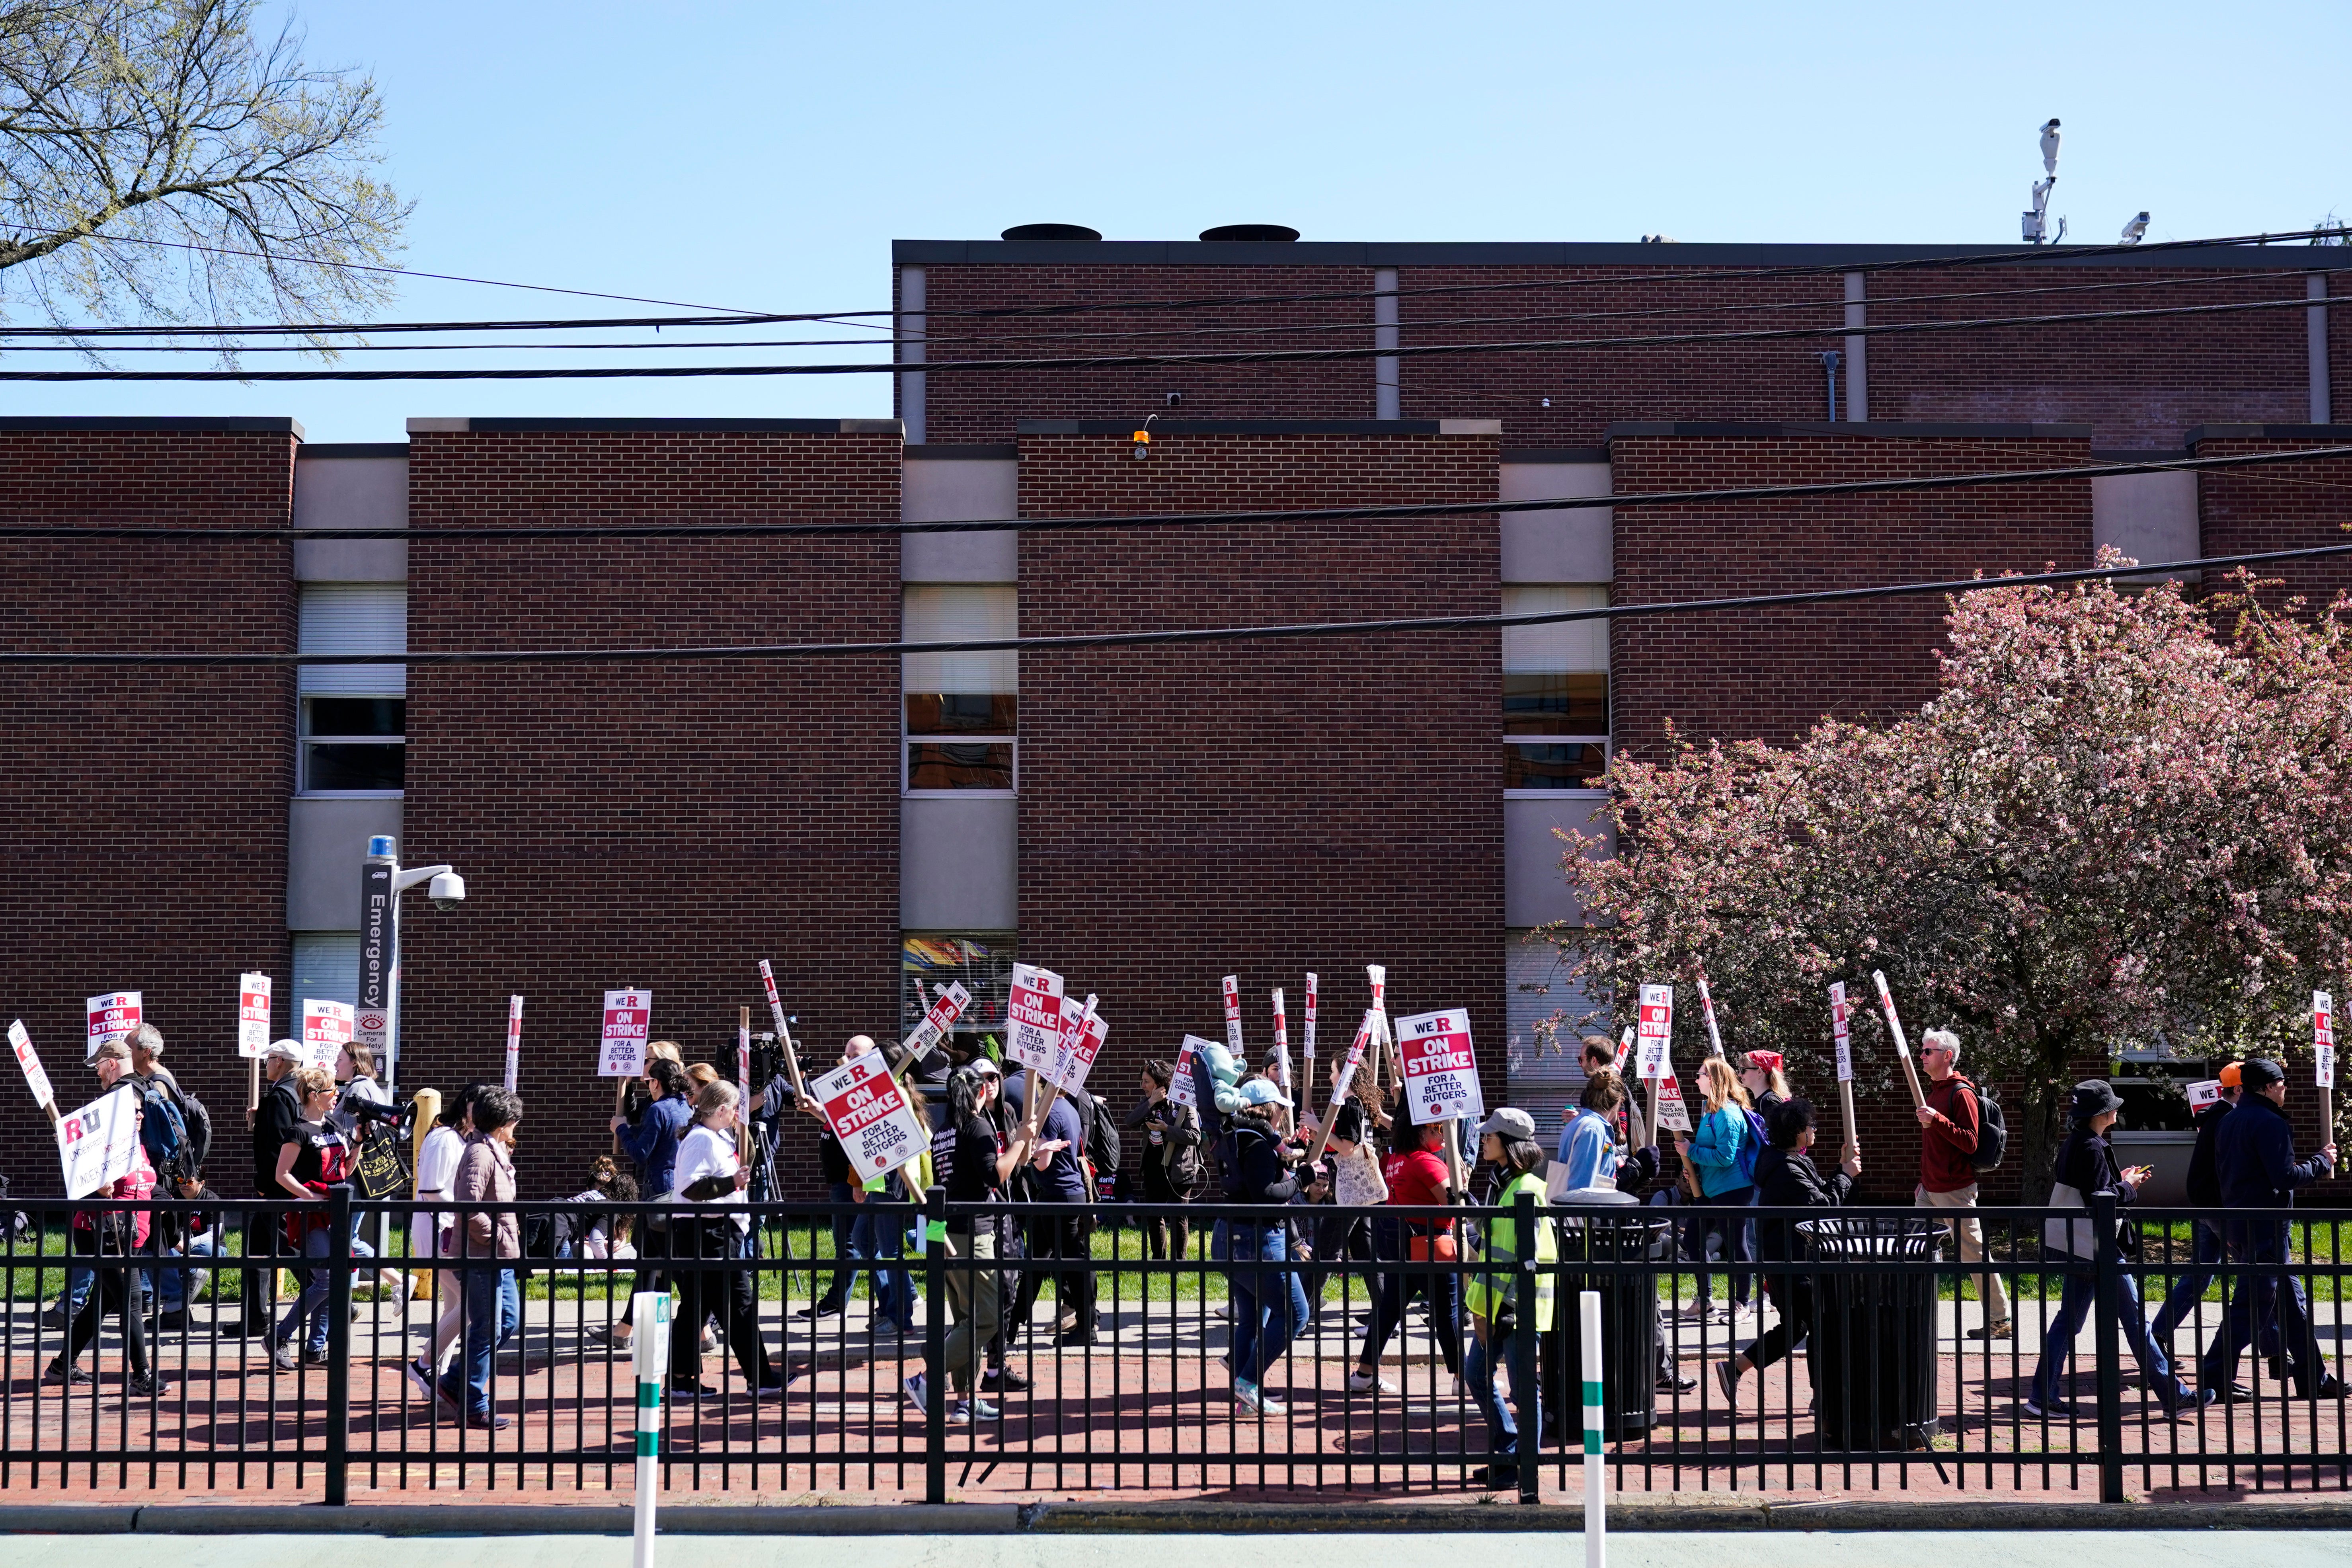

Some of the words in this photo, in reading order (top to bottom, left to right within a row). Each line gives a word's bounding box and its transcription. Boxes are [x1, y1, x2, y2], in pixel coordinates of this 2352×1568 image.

[365, 894, 385, 1008] Emergency
[261, 981, 265, 993] R
[1024, 974, 1036, 987] WE
[1036, 977, 1050, 992] R
[1226, 981, 1232, 992] R
[1307, 980, 1312, 991] R
[101, 999, 114, 1007] WE
[116, 997, 127, 1006] R
[253, 995, 264, 1008] ON
[626, 996, 638, 1007] R
[953, 992, 963, 1003] WE
[958, 998, 967, 1008] R
[1024, 993, 1043, 1010] ON
[1650, 993, 1660, 1002] WE
[1661, 992, 1667, 1004] R
[1833, 990, 1839, 1003] R
[2320, 999, 2329, 1009] WE
[104, 1009, 124, 1021] ON
[333, 1006, 341, 1017] R
[616, 1011, 633, 1024] ON
[944, 1005, 957, 1020] ON
[1011, 1002, 1057, 1029] STRIKE
[1652, 1008, 1666, 1022] ON
[92, 1018, 138, 1034] STRIKE
[320, 1018, 339, 1031] ON
[605, 1024, 645, 1037] STRIKE
[928, 1025, 938, 1036] FOR
[1020, 1024, 1035, 1035] FOR
[1036, 1028, 1041, 1037] A
[1414, 1022, 1434, 1034] WE
[1435, 1018, 1452, 1032] R
[307, 1028, 350, 1044] STRIKE
[1018, 1031, 1045, 1046] BETTER
[1016, 1038, 1047, 1054] RUTGERS
[1194, 1043, 1206, 1053] WE
[1423, 1037, 1450, 1055] ON
[1407, 1051, 1471, 1075] STRIKE
[832, 1074, 852, 1091] WE
[849, 1064, 870, 1083] R
[1174, 1079, 1195, 1089] STUDEN
[1428, 1075, 1447, 1085] FOR
[1424, 1082, 1463, 1094] BETTER
[2199, 1089, 2215, 1100] WE
[846, 1084, 875, 1110] ON
[1422, 1090, 1467, 1104] RUTGERS
[837, 1090, 901, 1134] STRIKE
[64, 1108, 101, 1145] RU
[862, 1123, 881, 1139] FOR
[883, 1119, 891, 1129] A
[862, 1125, 900, 1150] BETTER
[863, 1131, 907, 1160] RUTGERS
[76, 1166, 102, 1188] UNDER
